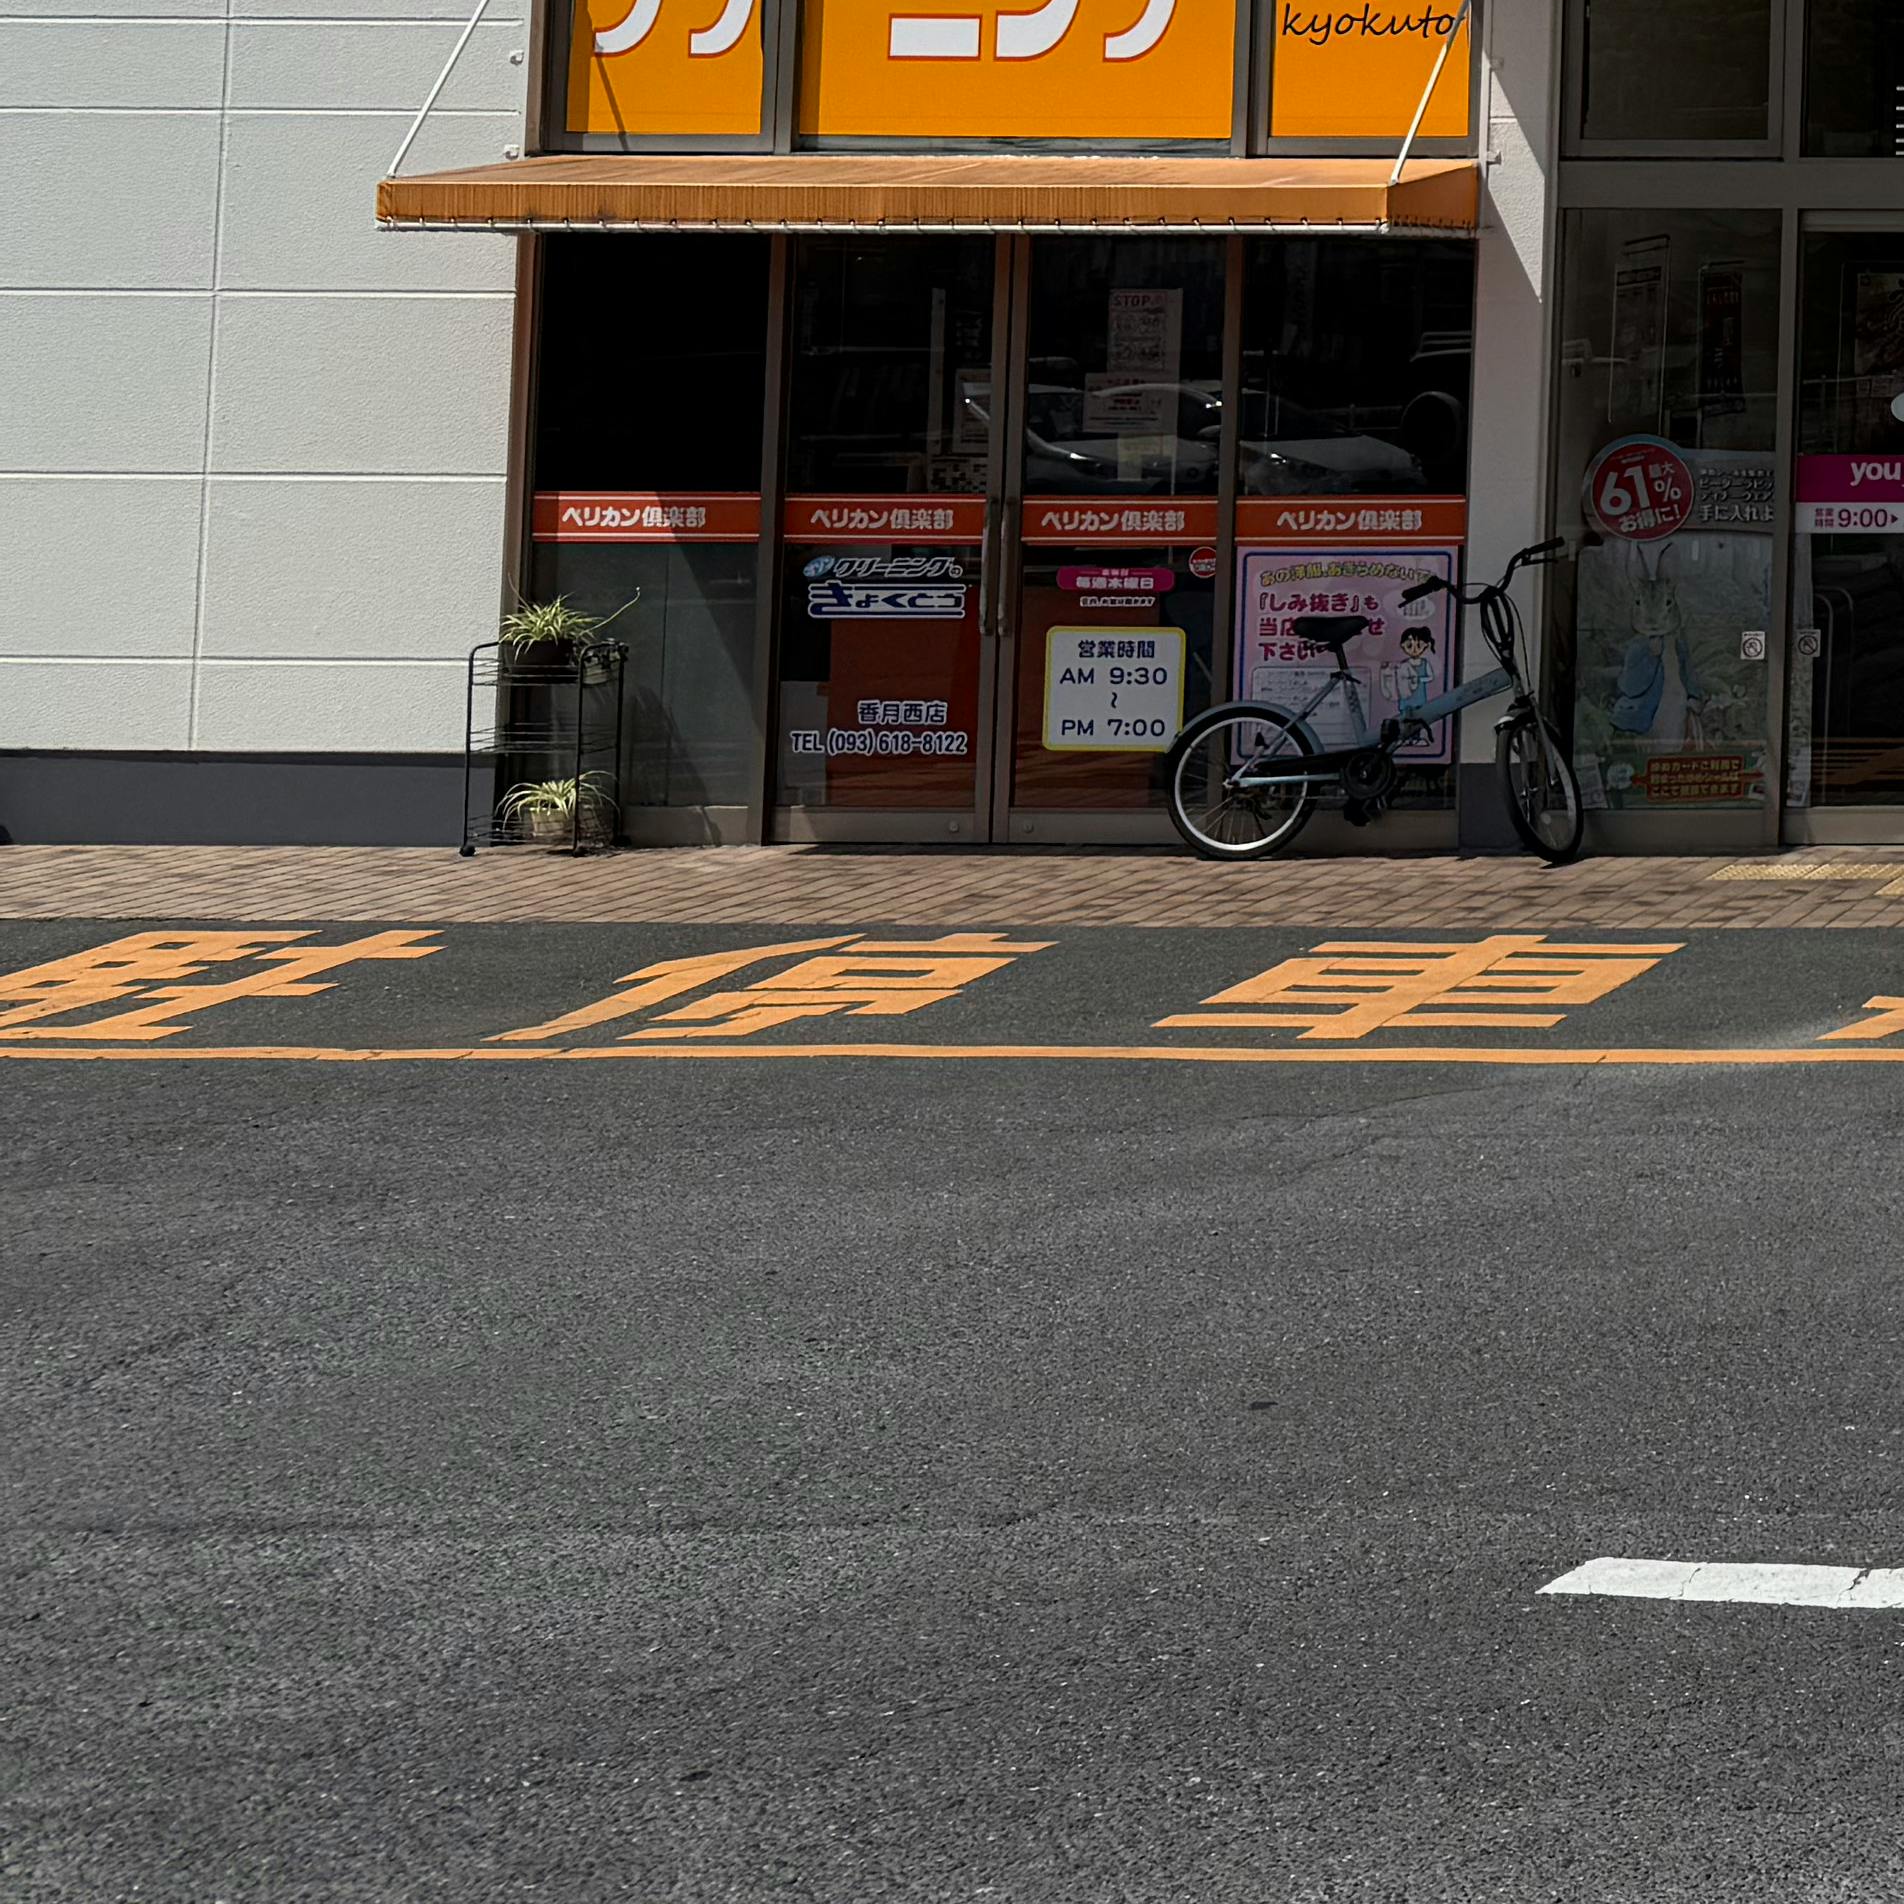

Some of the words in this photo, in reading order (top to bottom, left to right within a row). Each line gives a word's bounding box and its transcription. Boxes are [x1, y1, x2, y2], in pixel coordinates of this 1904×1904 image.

[1282, 3, 1463, 45] kyokuto
[1838, 508, 1888, 528] 9:00
[808, 580, 966, 618] きょくとう
[1078, 640, 1155, 658] 営業時間
[1059, 667, 1094, 684] AM
[1110, 667, 1168, 685] 9:30
[858, 701, 947, 725] 香月西店
[1061, 719, 1094, 736] PM
[1107, 719, 1165, 736] 7:00
[791, 731, 823, 752] TEL
